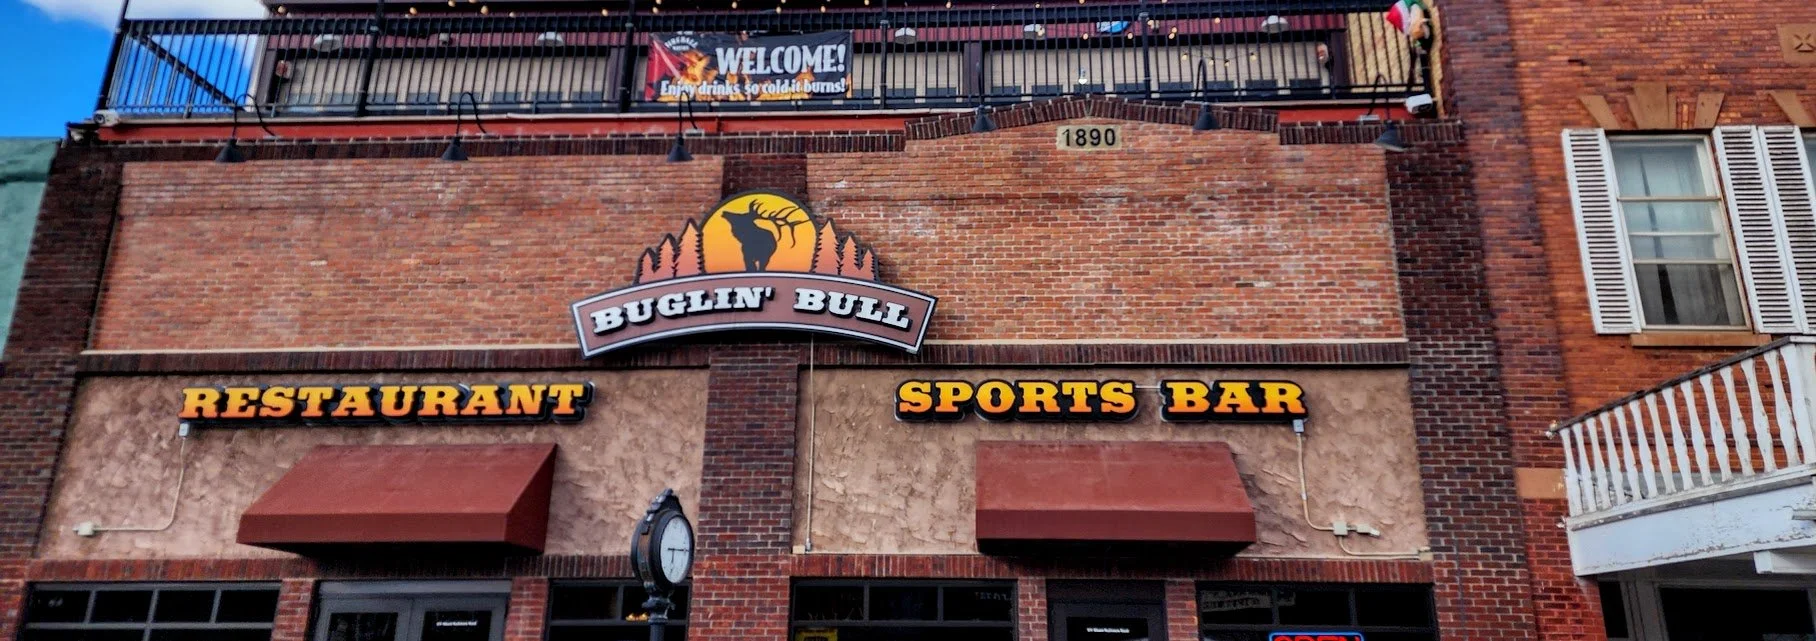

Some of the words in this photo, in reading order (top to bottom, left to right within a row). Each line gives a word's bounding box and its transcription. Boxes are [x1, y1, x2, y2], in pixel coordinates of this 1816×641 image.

[715, 44, 846, 75] WELCOME!
[660, 80, 696, 97] Enjoy
[698, 79, 741, 96] drinks
[744, 82, 759, 96] so
[762, 79, 786, 96] cold
[790, 80, 800, 94] it
[802, 77, 846, 94] burns!
[1062, 128, 1116, 147] 1890
[590, 287, 775, 334] BUGLIN'
[794, 287, 910, 330] BULL
[179, 383, 587, 419] RESTAURANT
[898, 380, 1137, 414] SPORTS
[1166, 381, 1307, 414] BAR
